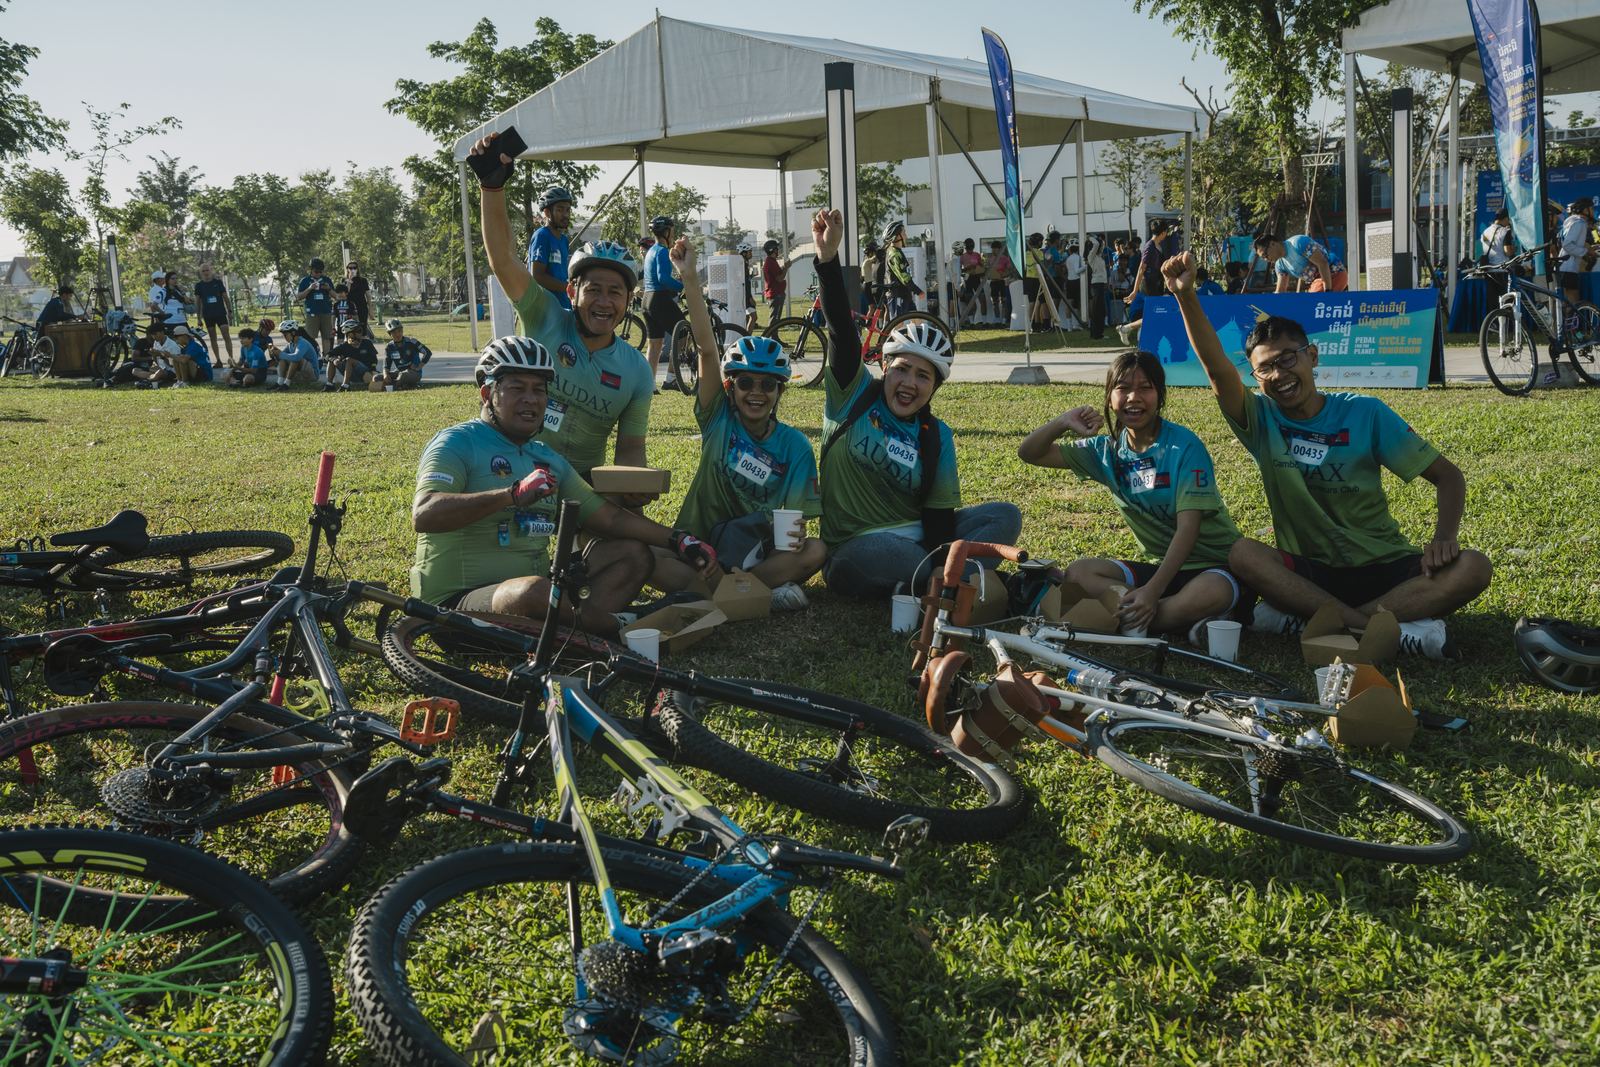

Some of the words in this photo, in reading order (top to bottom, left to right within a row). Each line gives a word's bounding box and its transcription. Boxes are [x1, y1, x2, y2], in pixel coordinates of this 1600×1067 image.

[1315, 300, 1353, 319] ជិះកង់
[1378, 336, 1406, 345] CYCLE
[888, 444, 915, 462] 00436
[1293, 444, 1324, 460] 00435
[740, 459, 767, 480] 00438
[854, 435, 914, 490] AUDA
[1132, 474, 1154, 488] 00437
[286, 940, 308, 971] HIGH
[295, 972, 311, 1019] ROLLER
